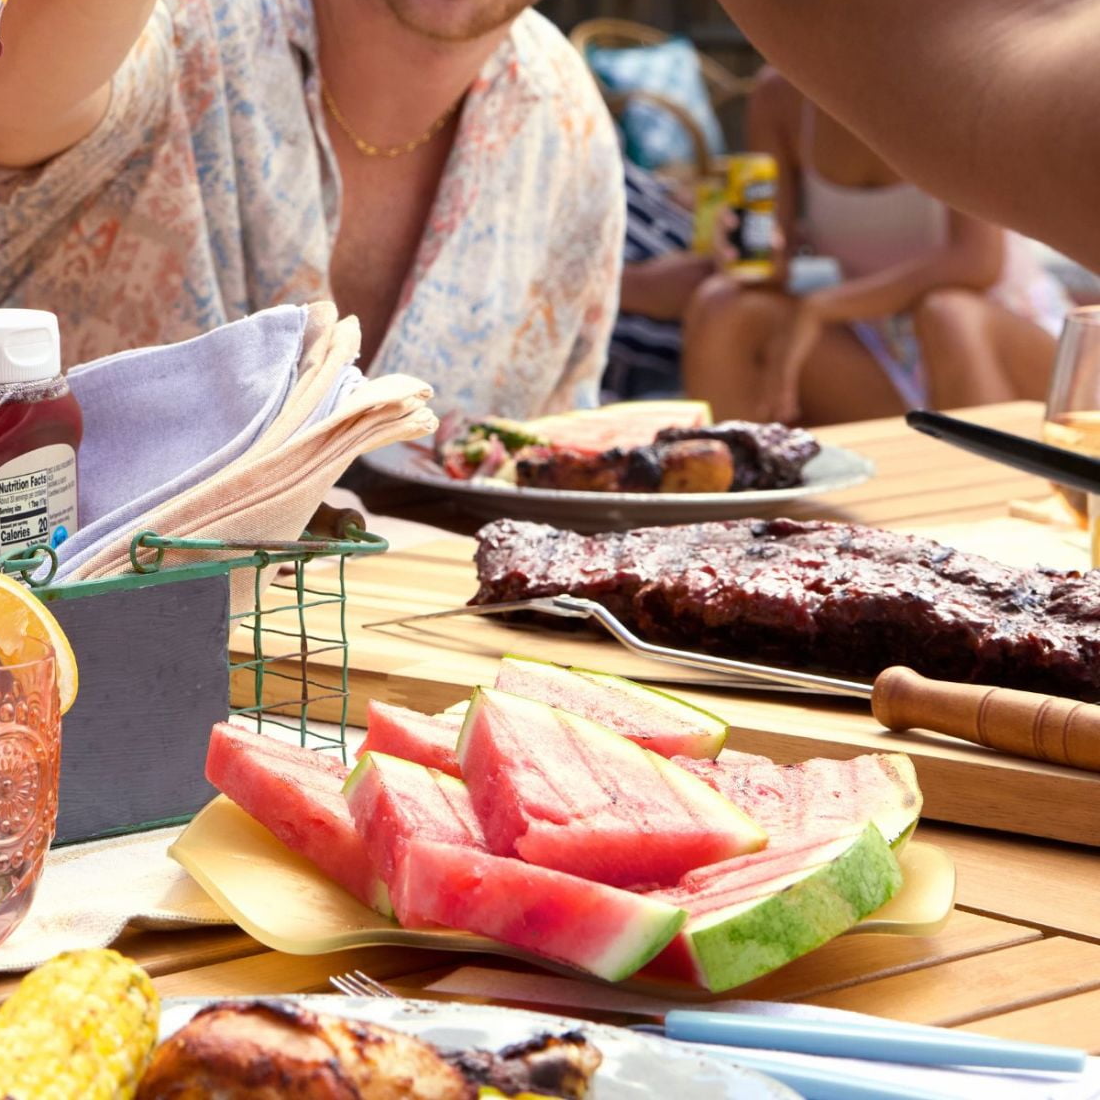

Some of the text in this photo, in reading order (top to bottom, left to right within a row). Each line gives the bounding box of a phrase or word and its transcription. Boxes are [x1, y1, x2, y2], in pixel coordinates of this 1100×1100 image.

[31, 474, 47, 488] Facts
[1, 527, 31, 542] Calories
[38, 517, 48, 533] 20
